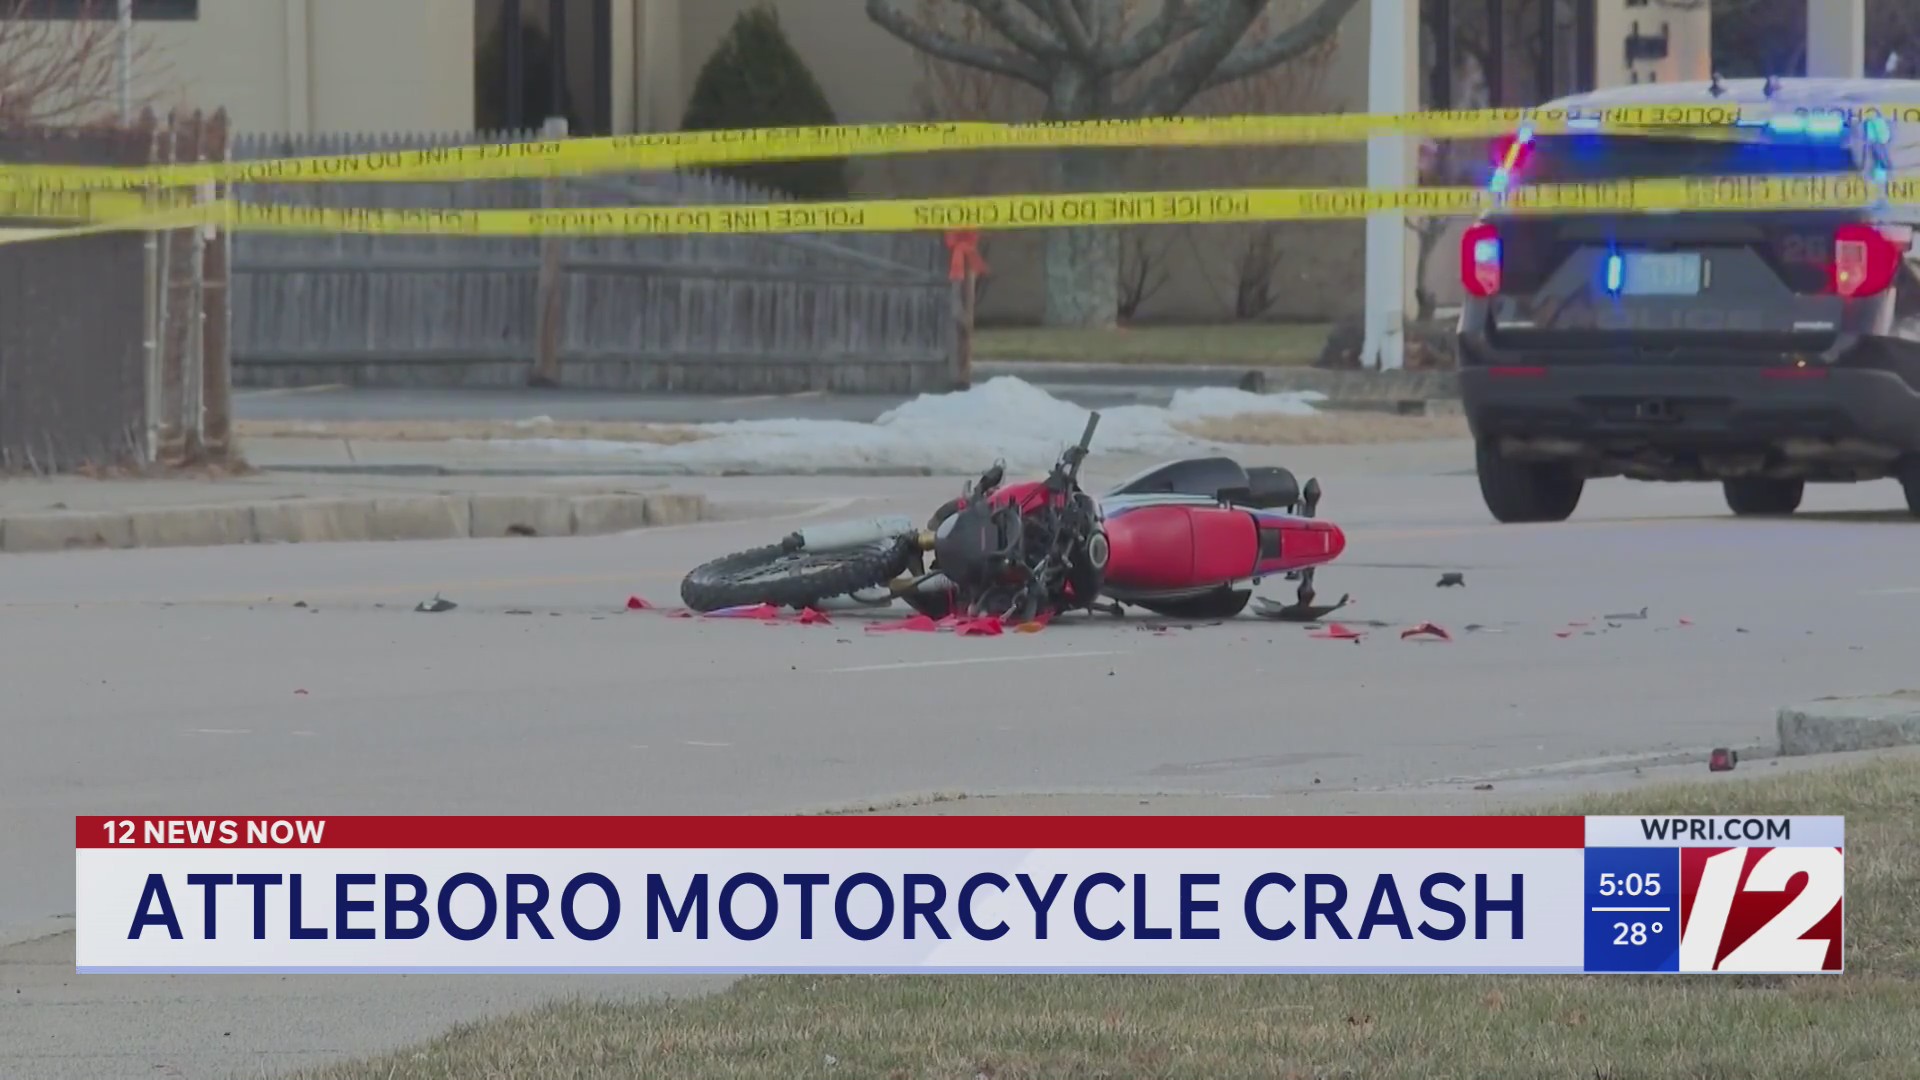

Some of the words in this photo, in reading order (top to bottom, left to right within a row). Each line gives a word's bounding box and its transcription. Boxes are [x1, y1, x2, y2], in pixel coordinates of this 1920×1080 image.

[1658, 106, 1743, 124] POLICE
[311, 157, 359, 174] NOT
[366, 150, 402, 169] DO
[1061, 199, 1098, 220] DO
[1103, 197, 1156, 218] LINE
[1162, 194, 1250, 218] POLICE
[1299, 190, 1385, 215] CROSS
[1392, 189, 1440, 210] NOT
[622, 211, 671, 228] NOT
[675, 210, 712, 229] DO
[718, 208, 770, 229] LINE
[777, 207, 866, 227] POLICE
[914, 204, 1000, 226] CROSS
[1007, 202, 1055, 223] NOT
